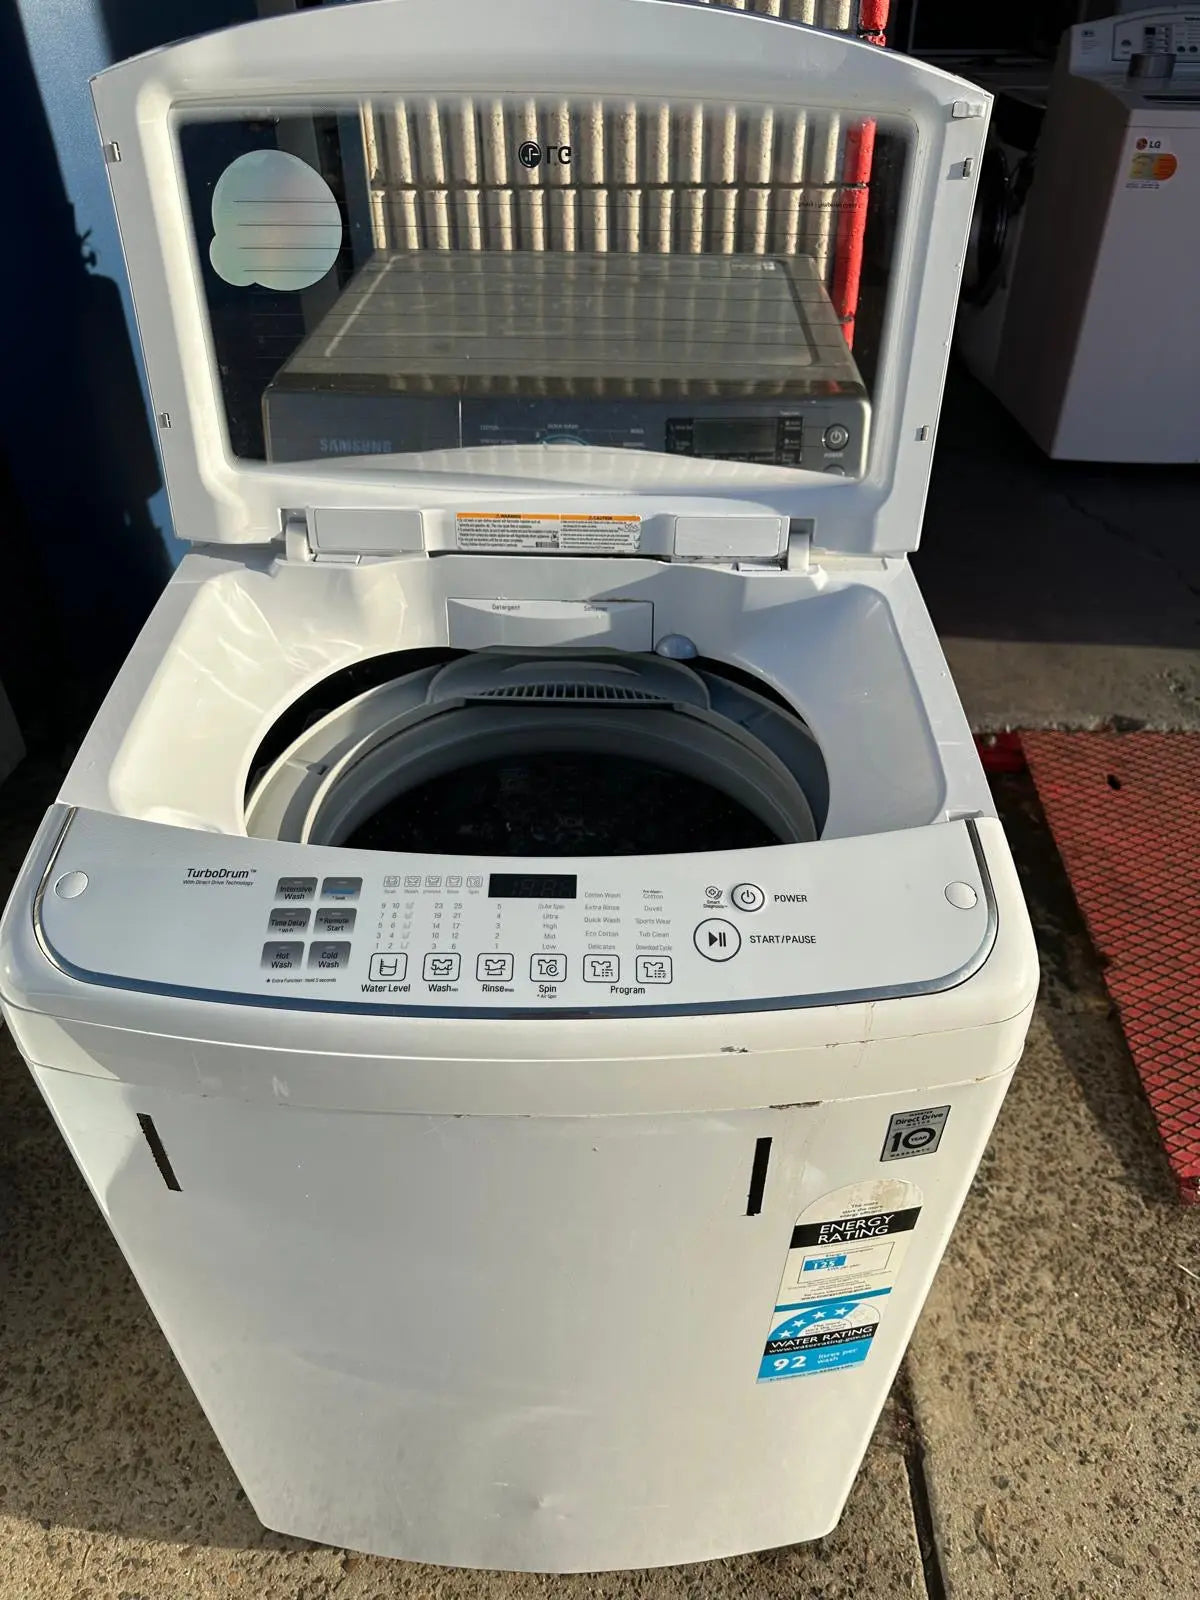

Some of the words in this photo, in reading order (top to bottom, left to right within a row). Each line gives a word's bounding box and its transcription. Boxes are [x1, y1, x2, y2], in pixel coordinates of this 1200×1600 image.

[320, 439, 392, 453] SAMSUNG
[774, 894, 808, 903] POWER
[288, 919, 306, 927] Delay
[749, 935, 817, 944] START/PAUSE
[361, 984, 387, 992] Water
[389, 984, 411, 992] Level
[428, 984, 451, 992] Wash
[482, 984, 504, 992] Rinse
[539, 985, 557, 994] Spin
[610, 985, 645, 995] Program
[896, 1116, 920, 1125] Direct
[891, 1128, 936, 1152] 10
[820, 1214, 895, 1234] ENERGY
[818, 1225, 889, 1244] RATING
[814, 1261, 836, 1269] 125
[771, 1337, 818, 1348] WATER
[823, 1326, 873, 1340] RATING
[769, 1333, 872, 1353] www.waterrating.gov.au
[842, 1348, 858, 1356] per
[773, 1356, 807, 1371] 92
